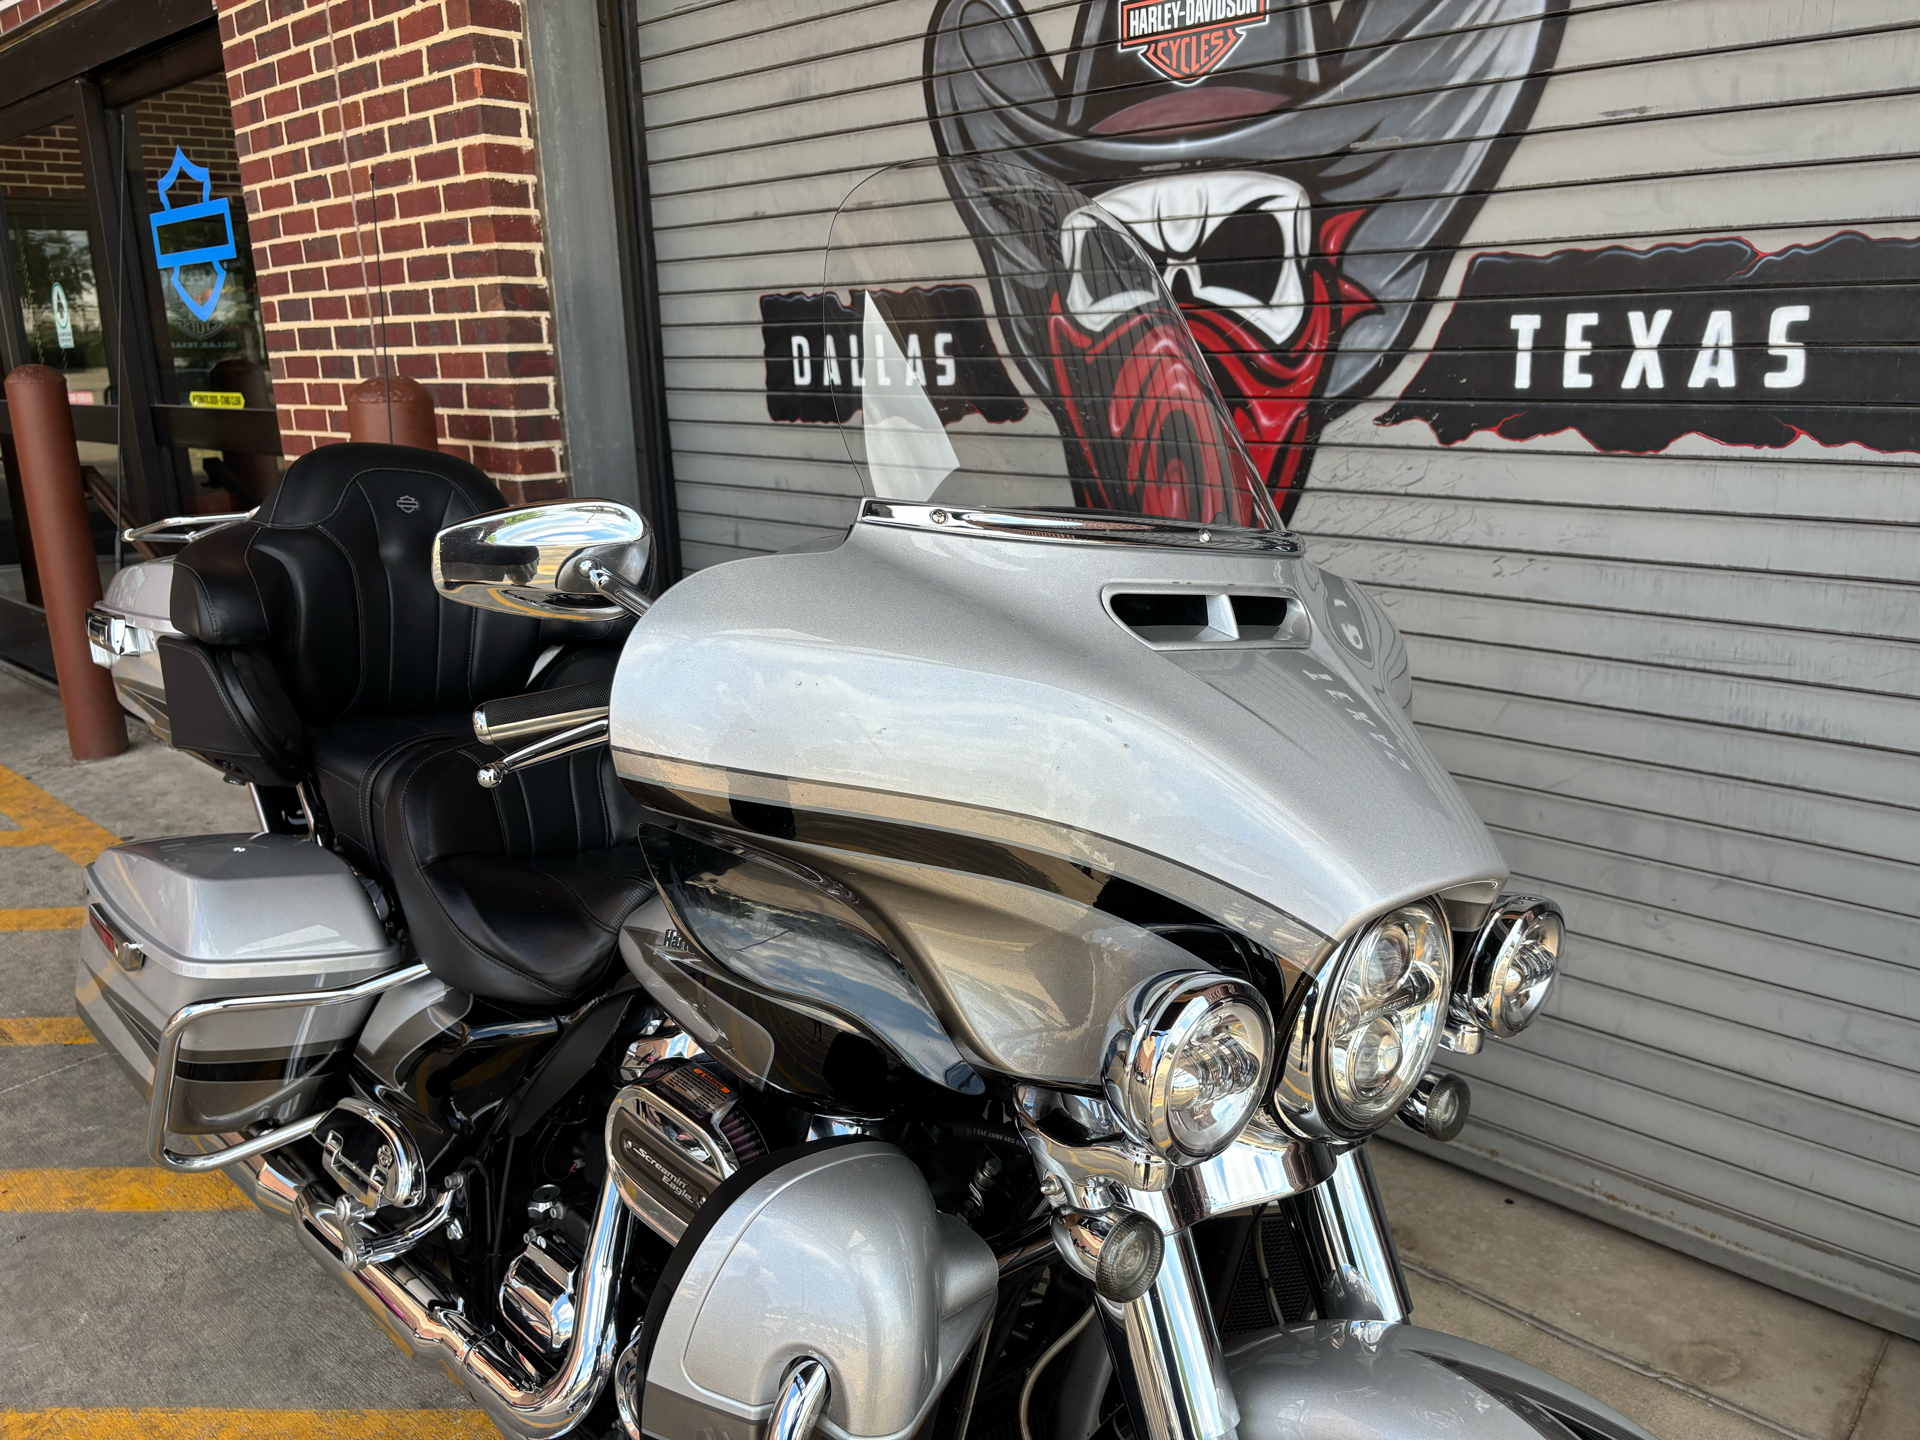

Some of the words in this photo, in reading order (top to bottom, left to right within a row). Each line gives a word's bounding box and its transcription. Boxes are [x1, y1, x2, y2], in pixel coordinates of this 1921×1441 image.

[1129, 0, 1258, 37] HARLEY-DAVIDSON
[1157, 30, 1224, 75] CYCLES
[791, 333, 956, 387] DALLAS
[1510, 305, 1810, 389] TEXAS
[977, 1129, 987, 1137] SAE
[633, 1148, 689, 1189] Screamin'
[661, 1174, 694, 1204] Eagle
